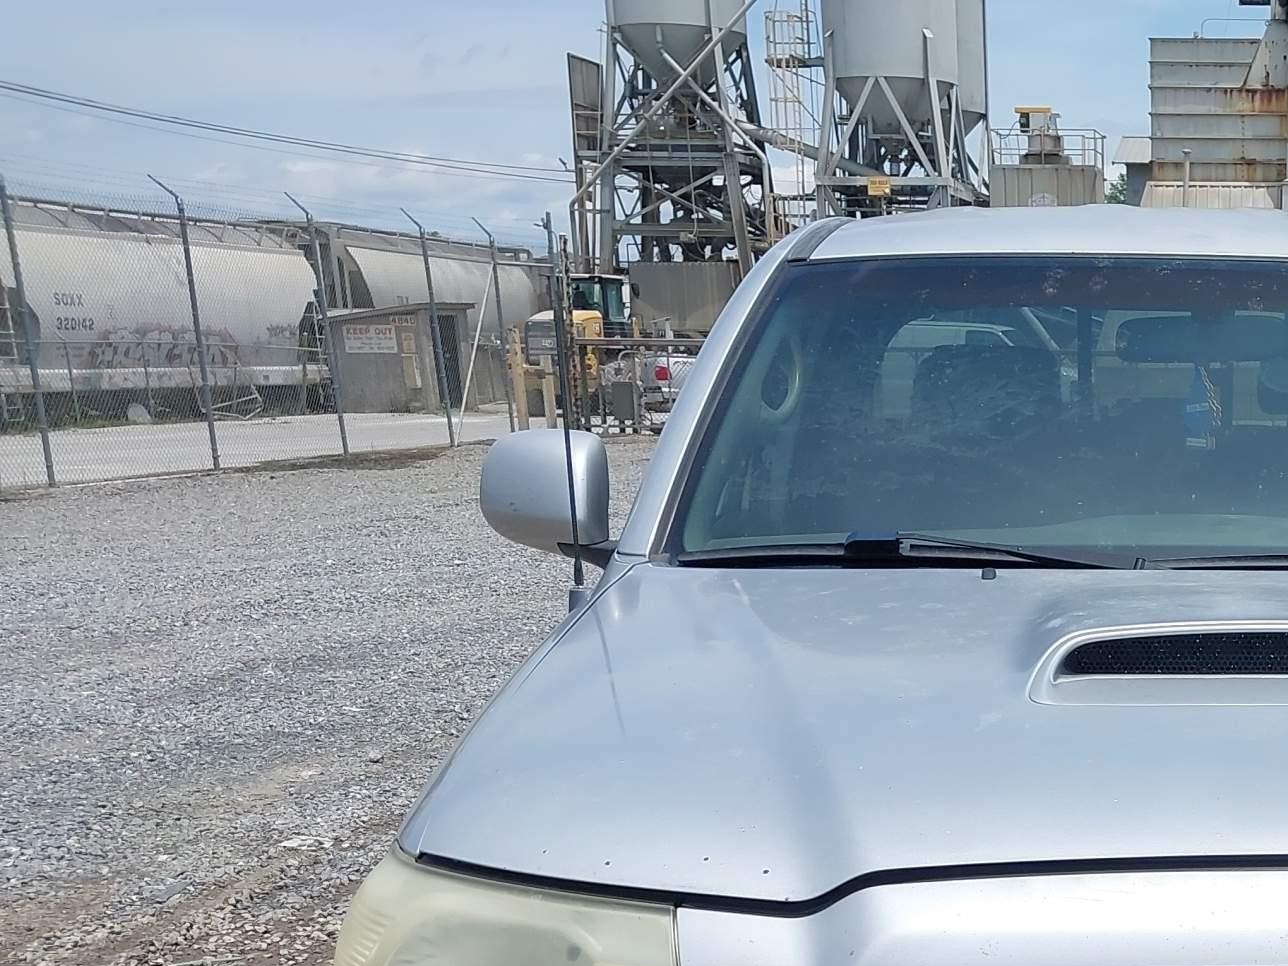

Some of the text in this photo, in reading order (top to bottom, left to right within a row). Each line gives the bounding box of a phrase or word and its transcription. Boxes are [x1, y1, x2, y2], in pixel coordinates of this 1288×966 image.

[56, 316, 95, 331] 320142
[346, 327, 393, 336] KEEP OUT
